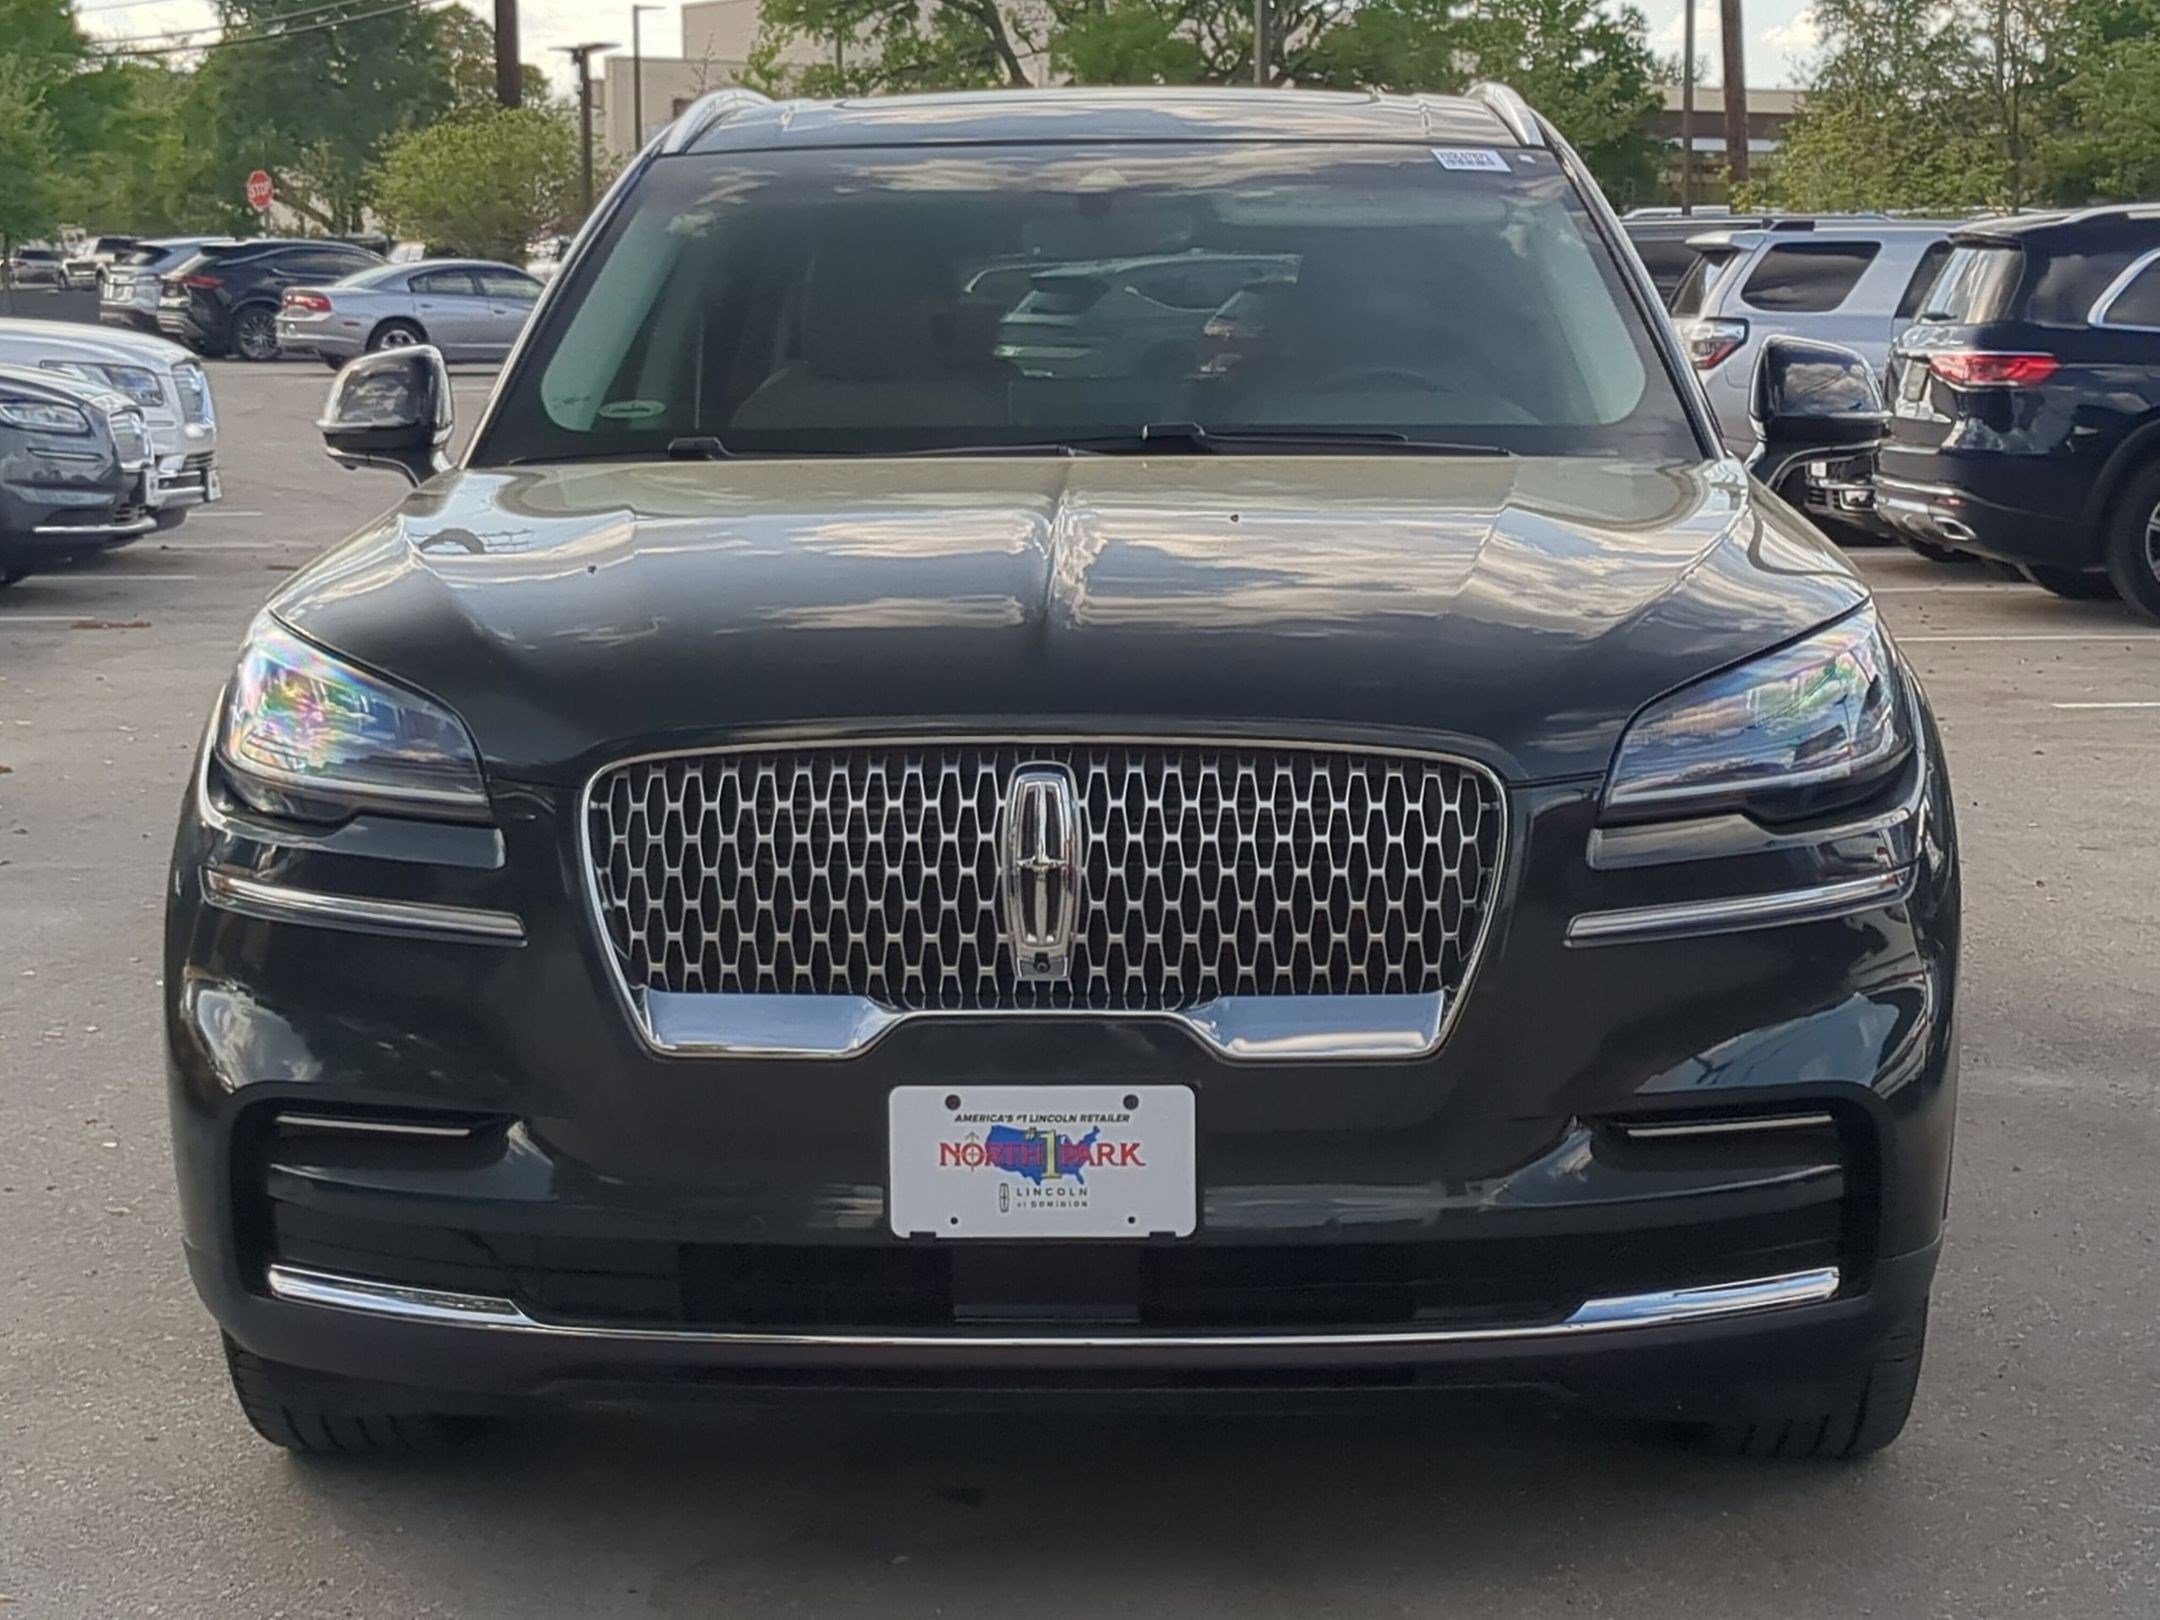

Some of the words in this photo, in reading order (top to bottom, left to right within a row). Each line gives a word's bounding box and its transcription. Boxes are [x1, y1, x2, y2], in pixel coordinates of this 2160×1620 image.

[249, 180, 272, 199] STOP
[954, 1113, 1014, 1122] AMERICA'S
[1028, 1114, 1077, 1123] LINCOLN
[1079, 1114, 1130, 1122] RETAILER
[939, 1142, 1043, 1167] NORTH
[1061, 1142, 1146, 1167] PARK
[1016, 1187, 1088, 1197] LINCOLN
[1031, 1200, 1088, 1208] DOMINION
